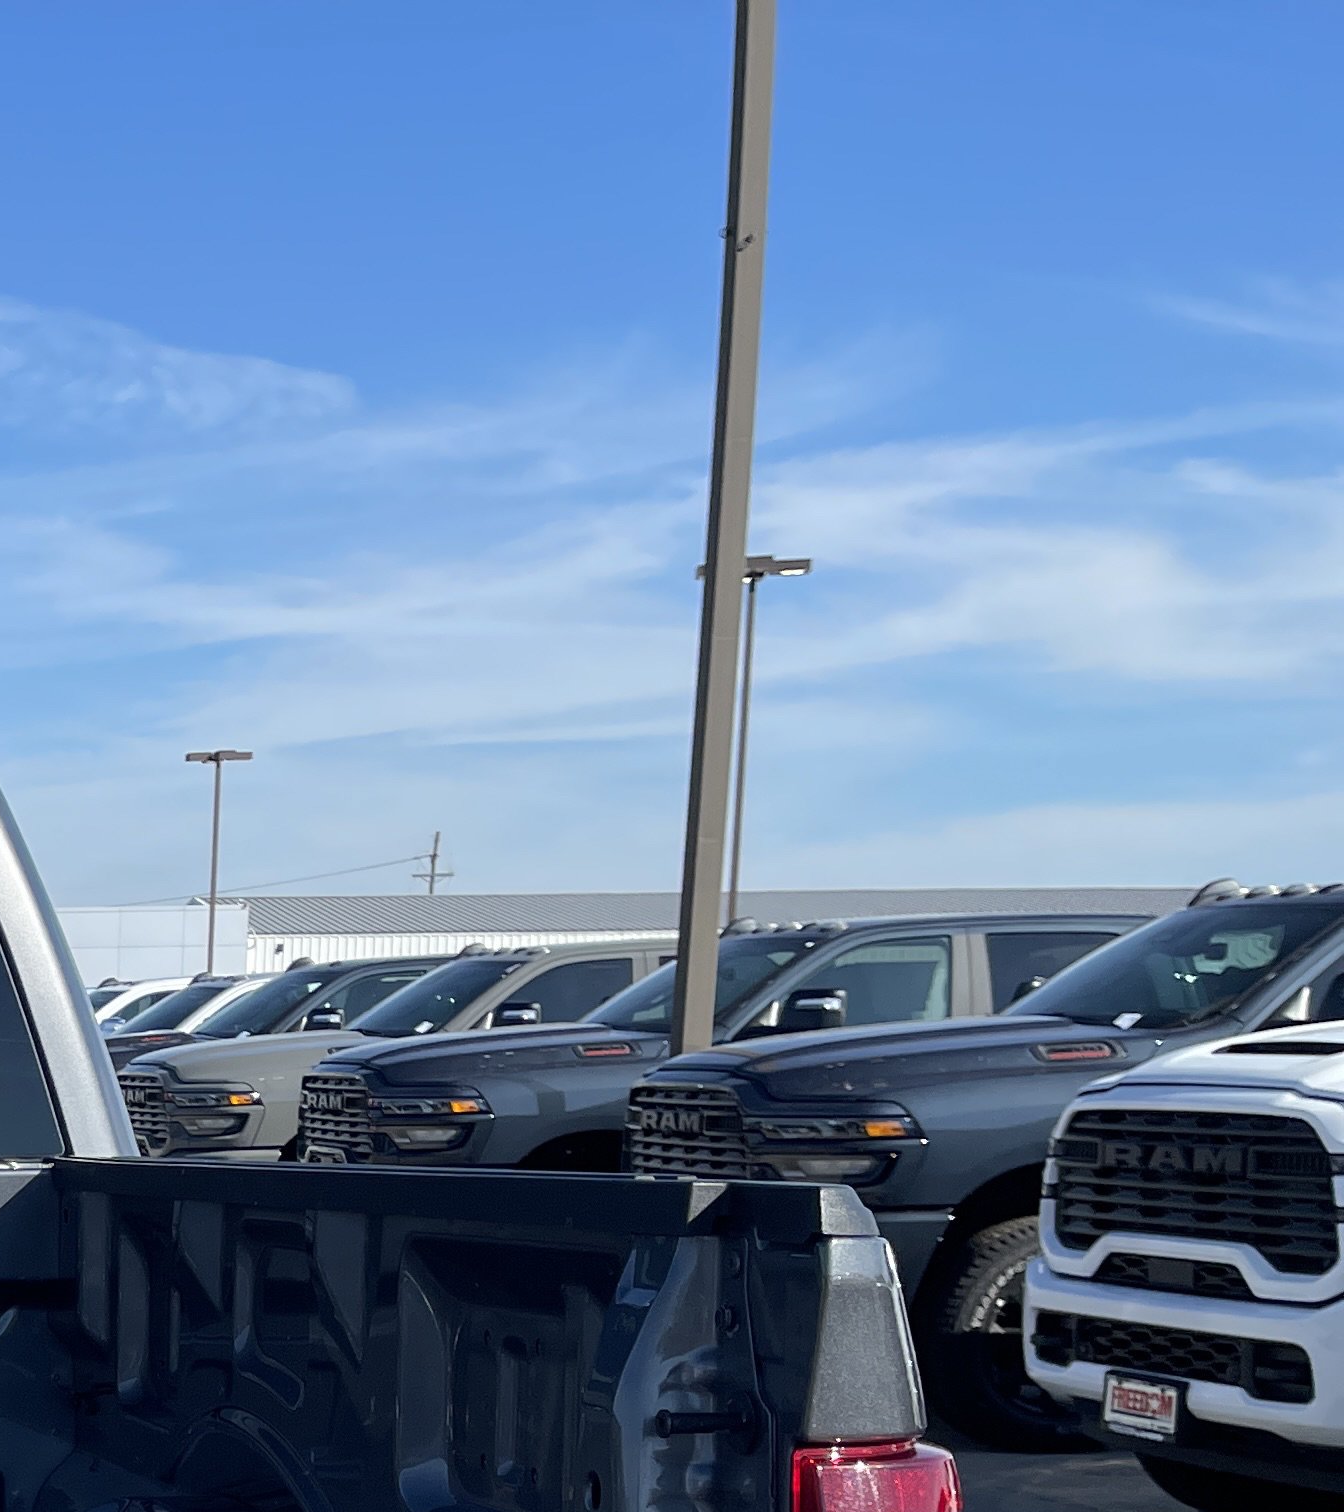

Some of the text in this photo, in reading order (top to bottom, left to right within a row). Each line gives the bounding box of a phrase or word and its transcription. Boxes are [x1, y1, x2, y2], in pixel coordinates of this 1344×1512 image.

[308, 1091, 343, 1110] RAM
[641, 1108, 700, 1133] RAM
[1104, 1142, 1242, 1172] RAM
